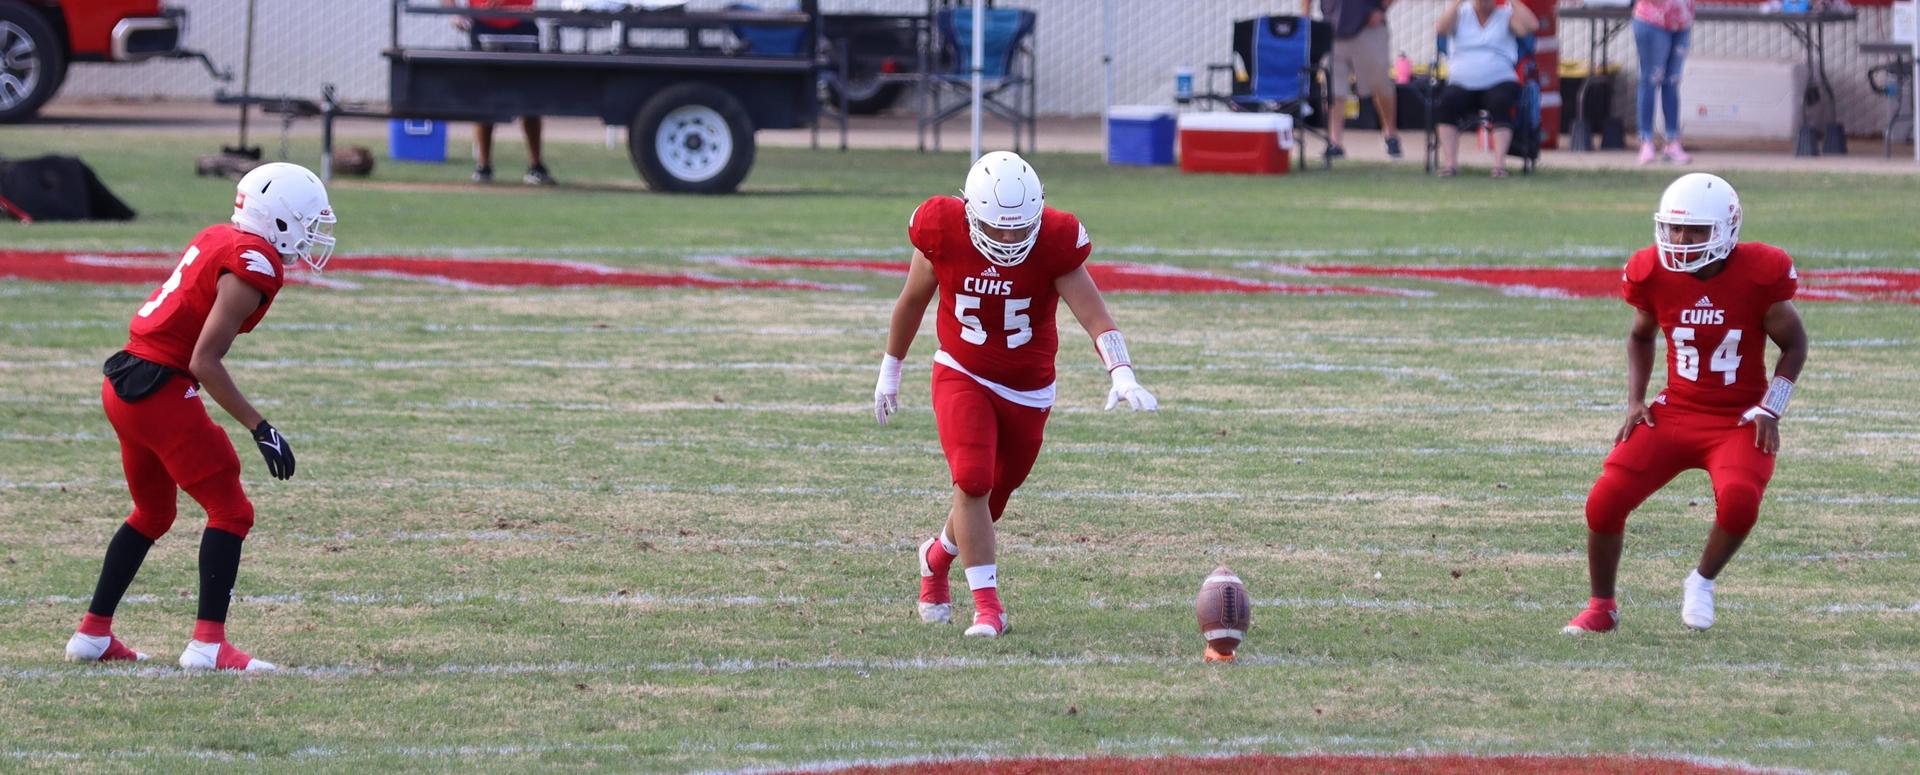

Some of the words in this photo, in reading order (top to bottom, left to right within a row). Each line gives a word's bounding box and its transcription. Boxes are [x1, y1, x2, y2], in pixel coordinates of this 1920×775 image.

[964, 277, 1013, 296] CUHS
[954, 294, 1033, 349] 55
[1681, 309, 1725, 324] CUHS
[1672, 328, 1743, 386] 64
